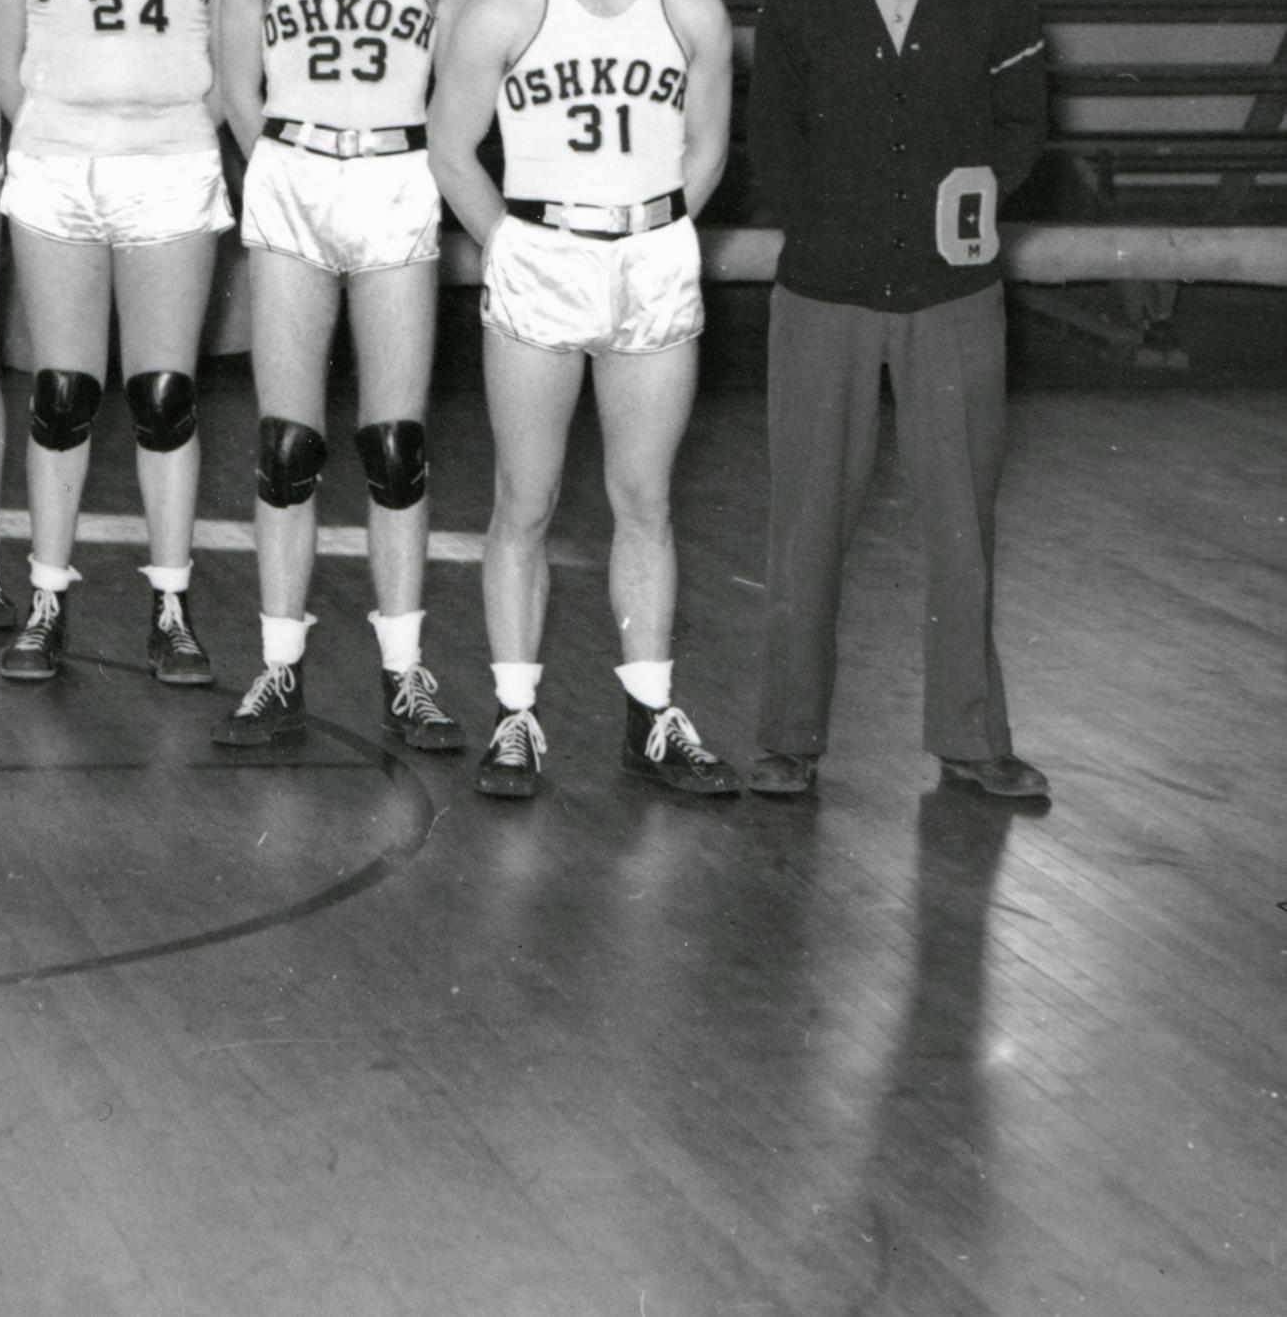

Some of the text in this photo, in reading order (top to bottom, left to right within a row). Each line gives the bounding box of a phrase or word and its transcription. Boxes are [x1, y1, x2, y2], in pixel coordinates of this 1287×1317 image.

[307, 36, 388, 82] 23
[504, 58, 688, 112] OSHKOSH
[566, 103, 631, 153] 31
[936, 166, 1000, 266] O
[968, 244, 981, 258] M
